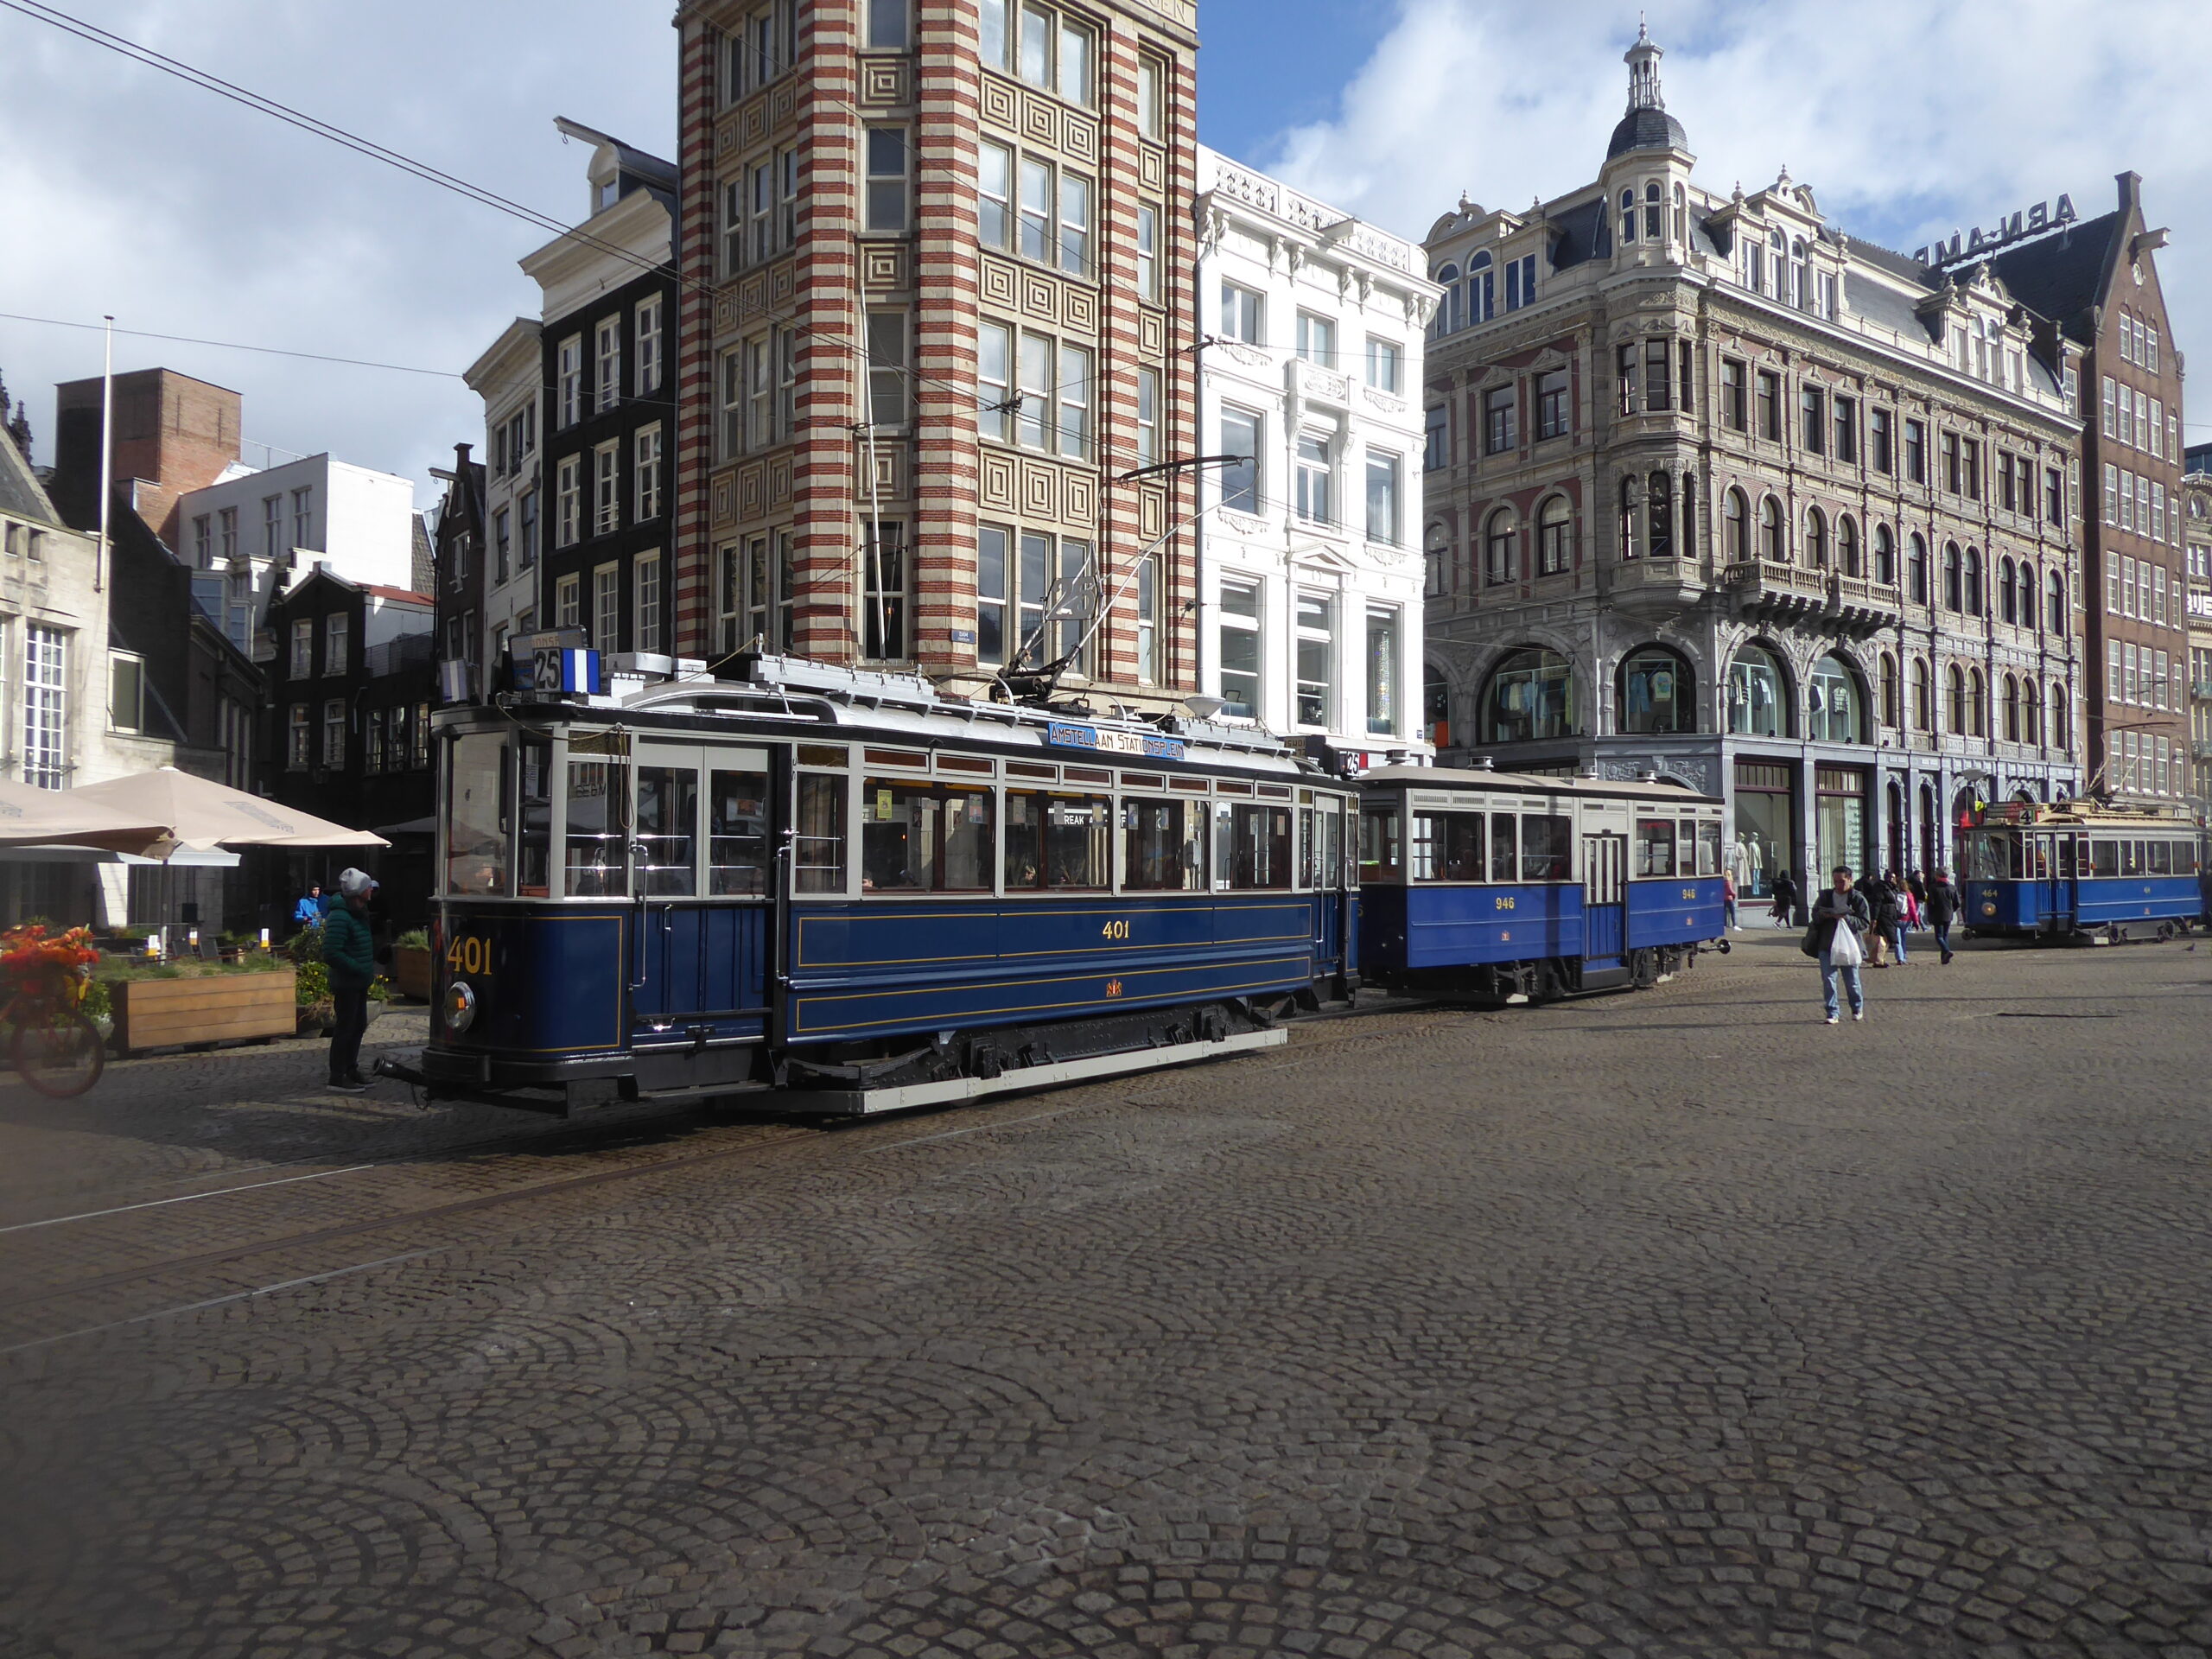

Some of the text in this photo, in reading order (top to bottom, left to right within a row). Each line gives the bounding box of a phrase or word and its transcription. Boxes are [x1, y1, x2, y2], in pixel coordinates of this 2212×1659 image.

[536, 651, 559, 690] 25
[1051, 723, 1185, 758] AMSTELLAAN STATIONSPLEIN
[1348, 753, 1359, 775] 25
[2020, 810, 2031, 824] 4
[1682, 888, 1695, 899] 946
[1981, 889, 1999, 898] 464
[1496, 897, 1515, 910] 946
[1103, 920, 1129, 939] 401
[448, 936, 492, 976] 401
